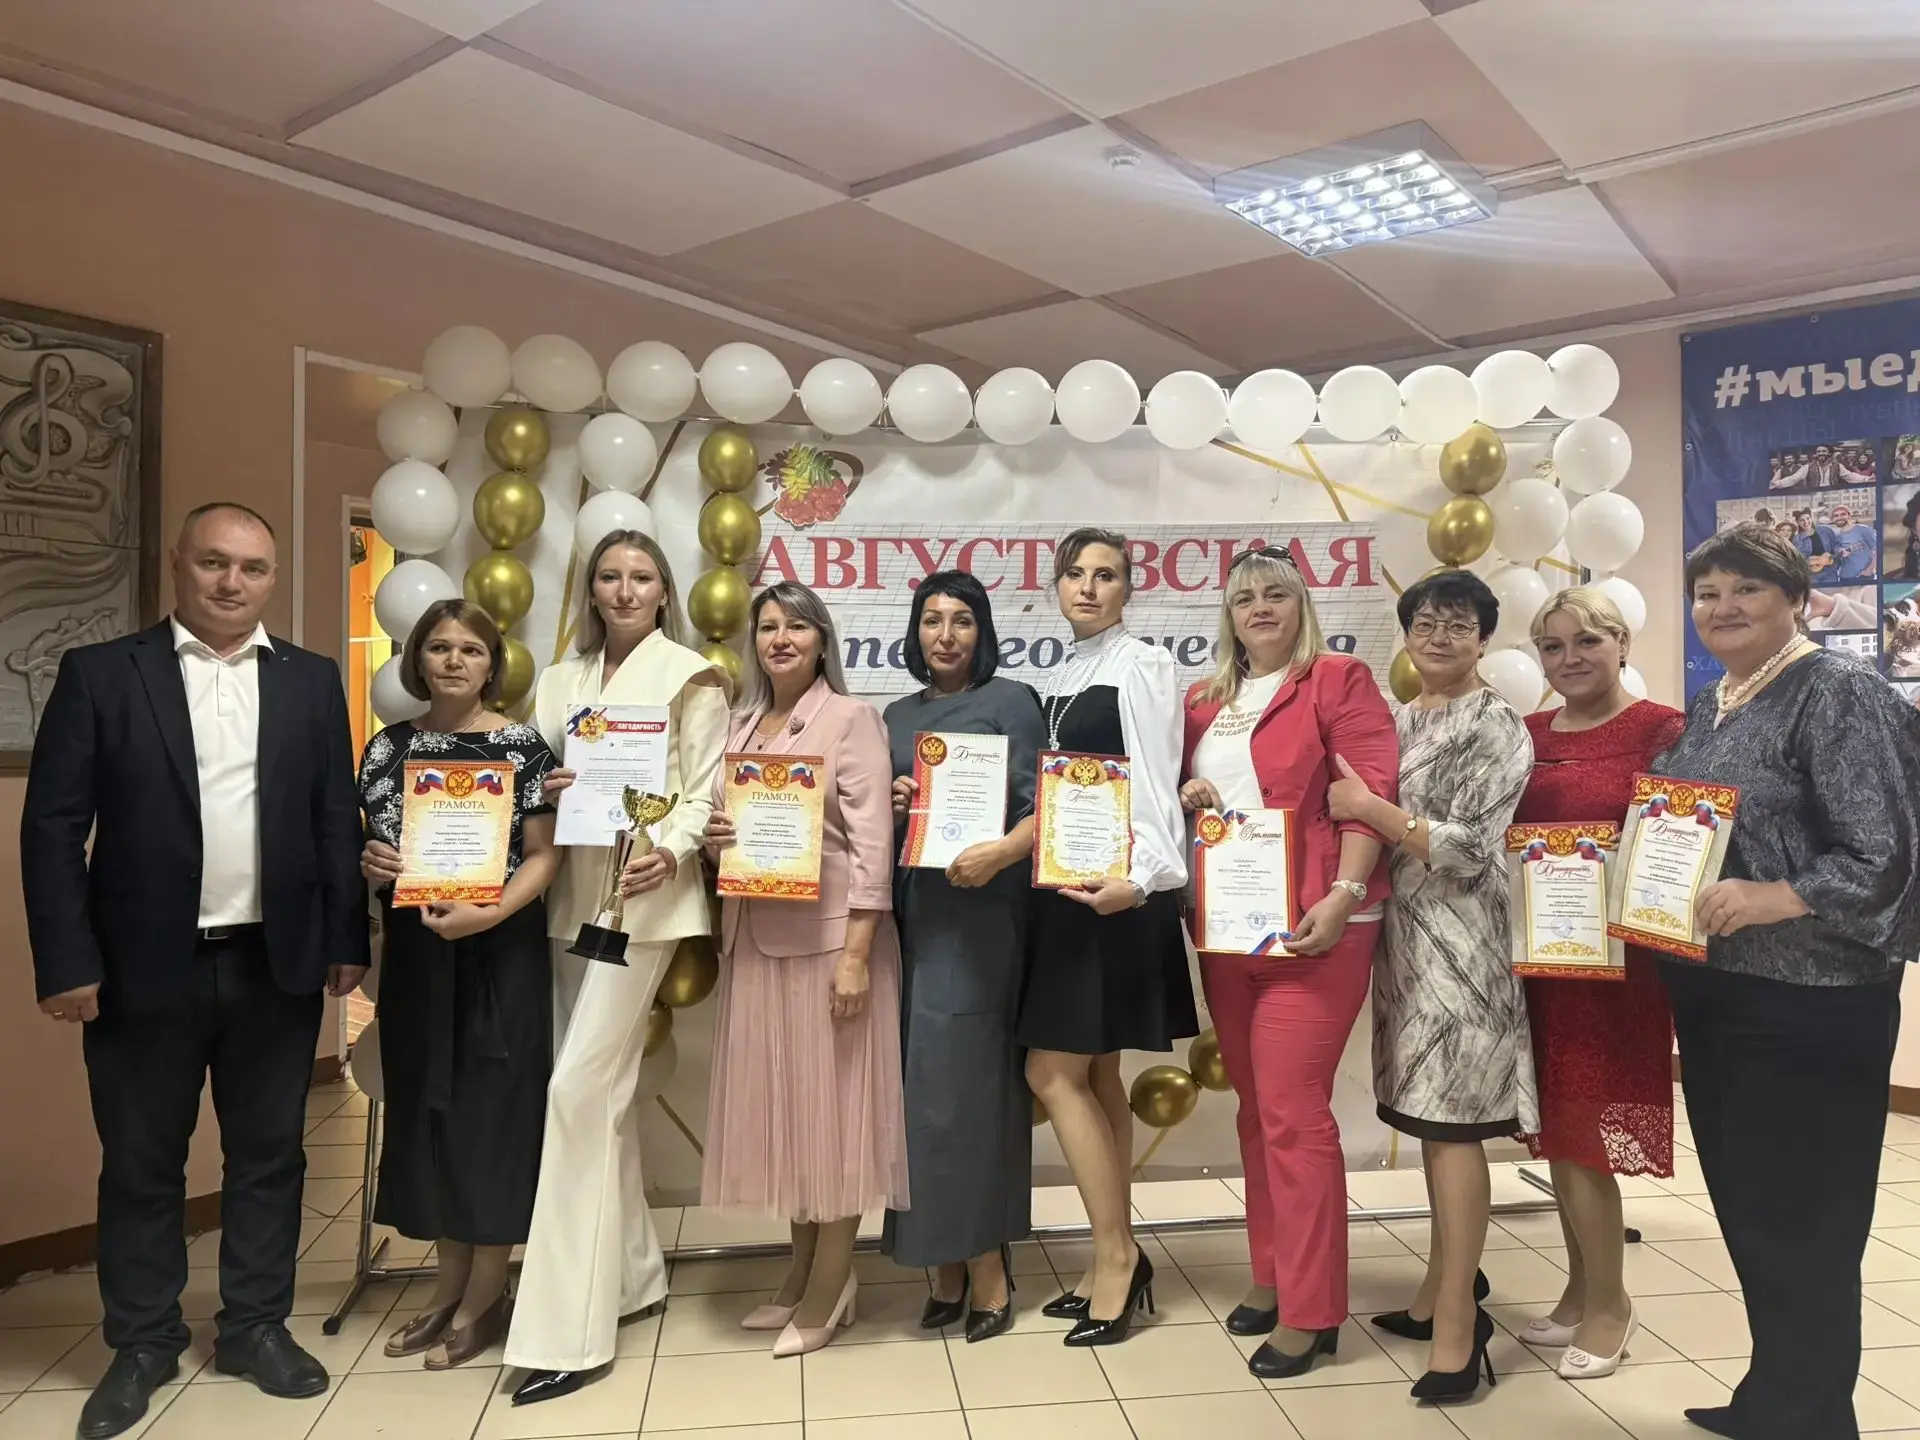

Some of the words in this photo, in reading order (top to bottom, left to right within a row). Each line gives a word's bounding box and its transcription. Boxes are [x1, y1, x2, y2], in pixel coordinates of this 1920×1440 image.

[750, 535, 1379, 592] АВГУСТВСКАЯ
[752, 791, 800, 802] ГРАМОТА
[433, 800, 486, 809] ГРАМОТА
[1239, 822, 1283, 842] Грамота
